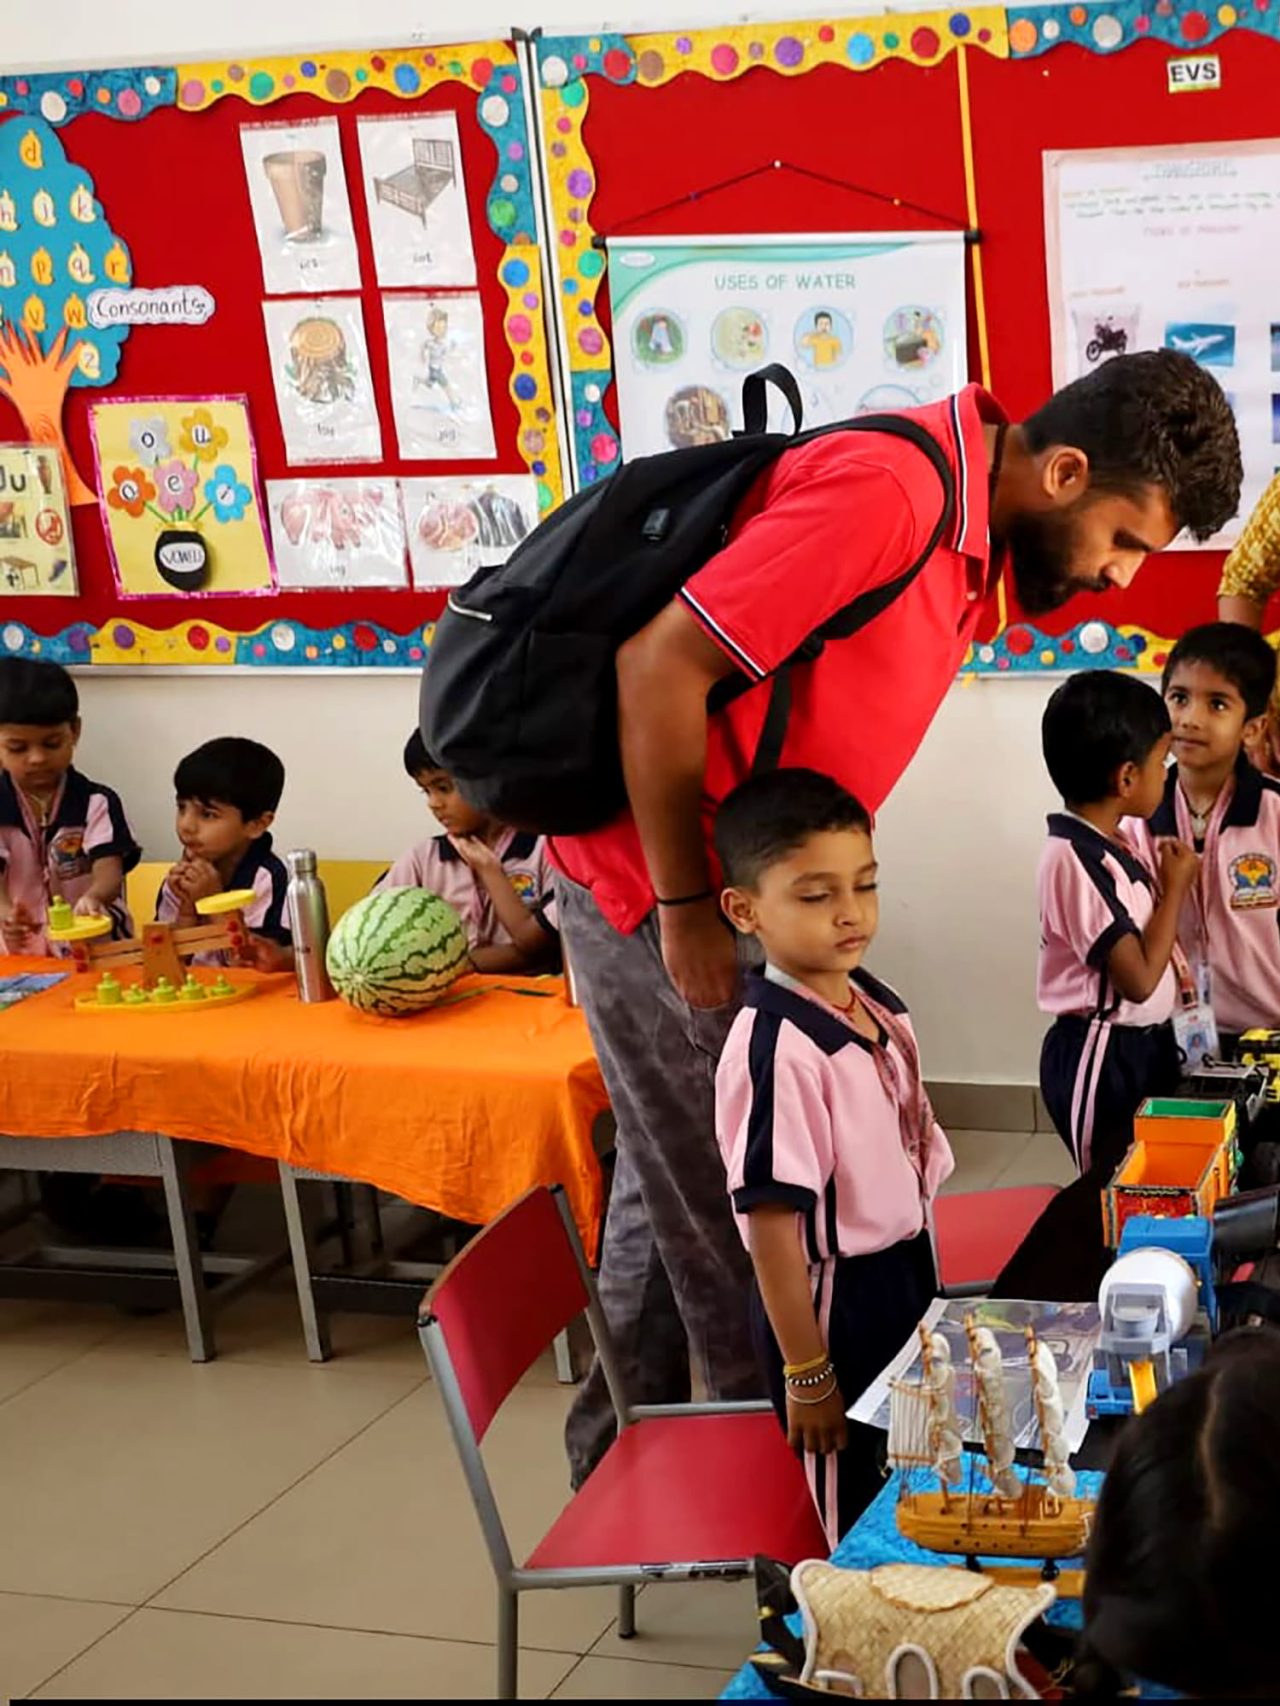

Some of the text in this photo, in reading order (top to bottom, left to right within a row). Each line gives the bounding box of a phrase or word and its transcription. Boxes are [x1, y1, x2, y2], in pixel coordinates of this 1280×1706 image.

[1170, 61, 1217, 83] EVS
[25, 142, 36, 161] d
[78, 194, 88, 219] k
[36, 260, 46, 282] p
[72, 258, 87, 279] q
[110, 260, 119, 276] r
[713, 272, 857, 291] USES OF WATER
[28, 307, 40, 327] v
[96, 289, 207, 318] Consonants
[141, 426, 207, 449] o u
[167, 474, 182, 493] e
